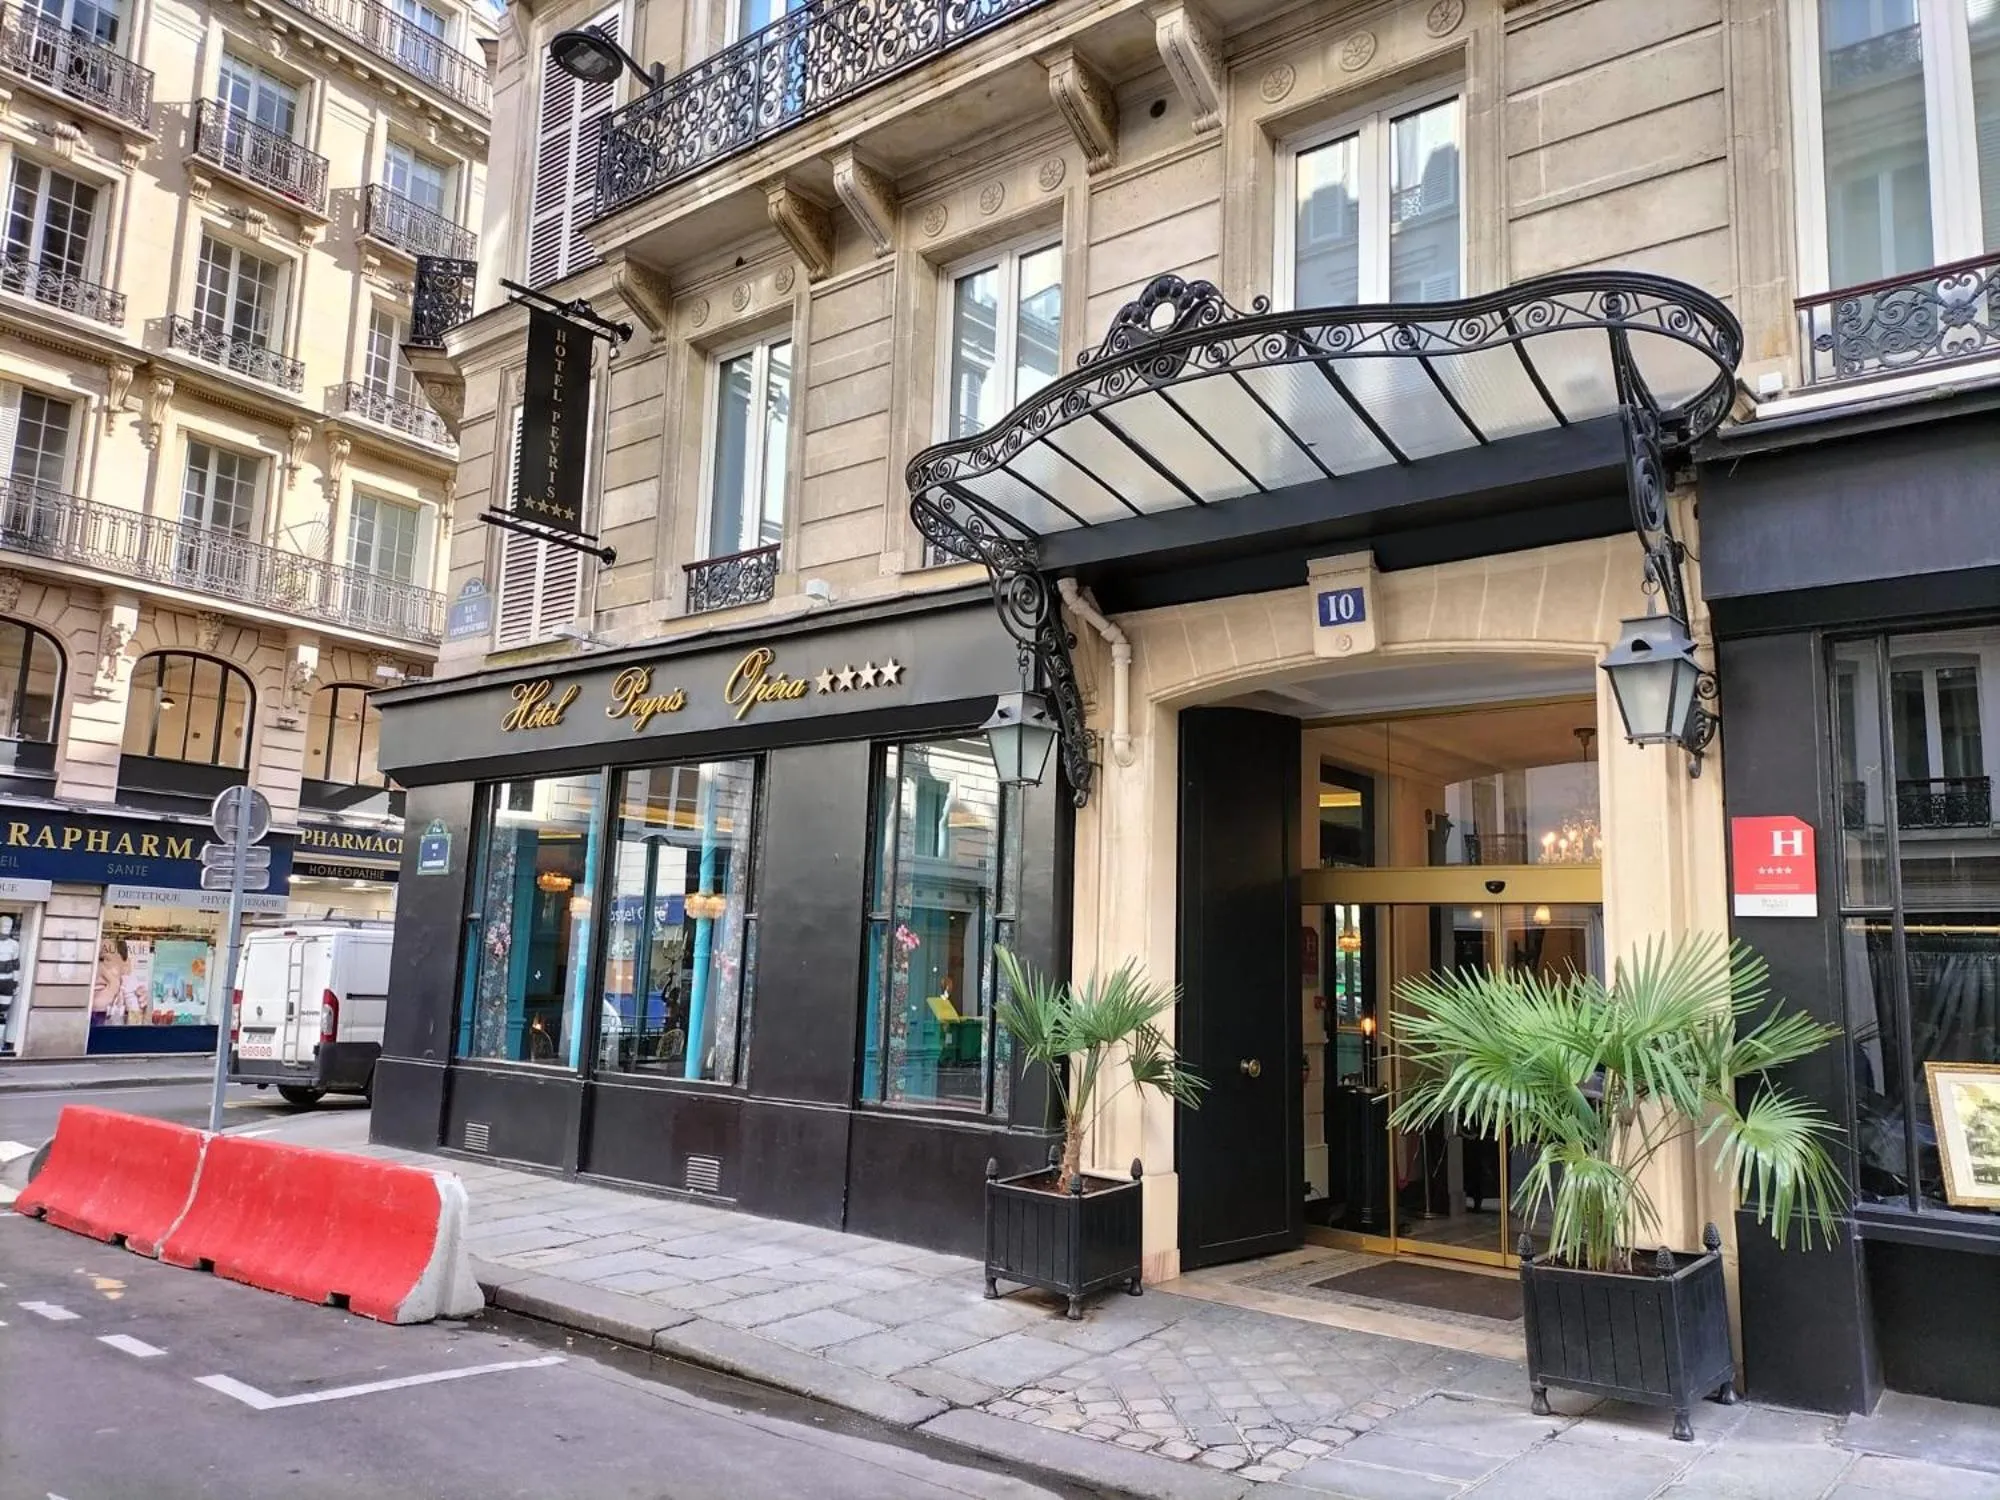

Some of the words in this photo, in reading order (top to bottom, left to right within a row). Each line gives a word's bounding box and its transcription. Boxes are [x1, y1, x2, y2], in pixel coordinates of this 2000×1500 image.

[551, 329, 567, 402] HOTEL
[546, 410, 560, 499] PEYRIS
[1327, 593, 1355, 621] 10
[500, 679, 582, 733] Hôtel
[606, 664, 687, 732] Peyris
[724, 646, 808, 720] Opéra
[0, 821, 206, 861] RAPHARM
[1769, 829, 1808, 857] H
[308, 864, 385, 881] HOMEOPATHIE
